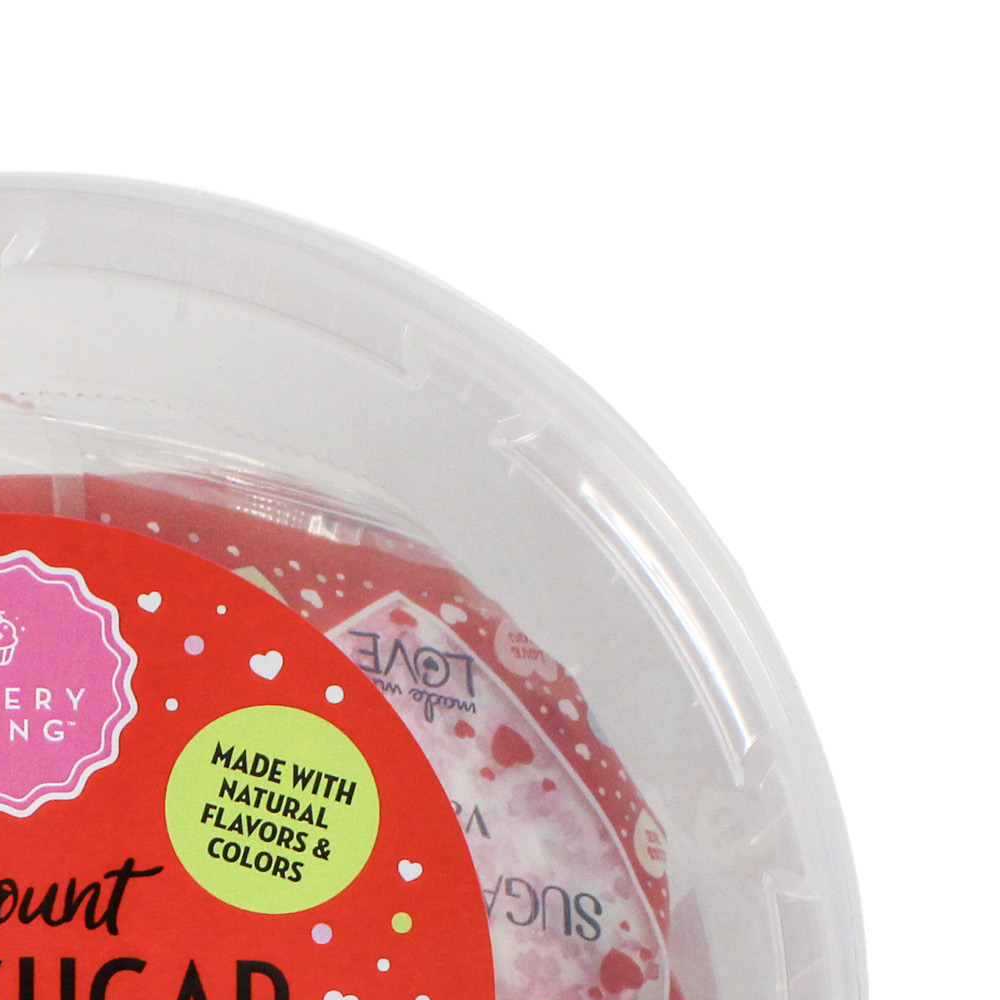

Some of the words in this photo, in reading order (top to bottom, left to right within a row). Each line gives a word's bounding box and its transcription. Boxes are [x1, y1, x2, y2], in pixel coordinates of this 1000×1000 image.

[348, 630, 475, 698] LOVE
[409, 688, 476, 723] made
[211, 741, 286, 784] MADE
[292, 763, 357, 806] WITH
[200, 803, 309, 853] FLAVORS
[312, 838, 331, 861] &
[218, 777, 328, 829] NATURAL
[207, 837, 304, 883] COLORS
[484, 875, 603, 941] SUGA
